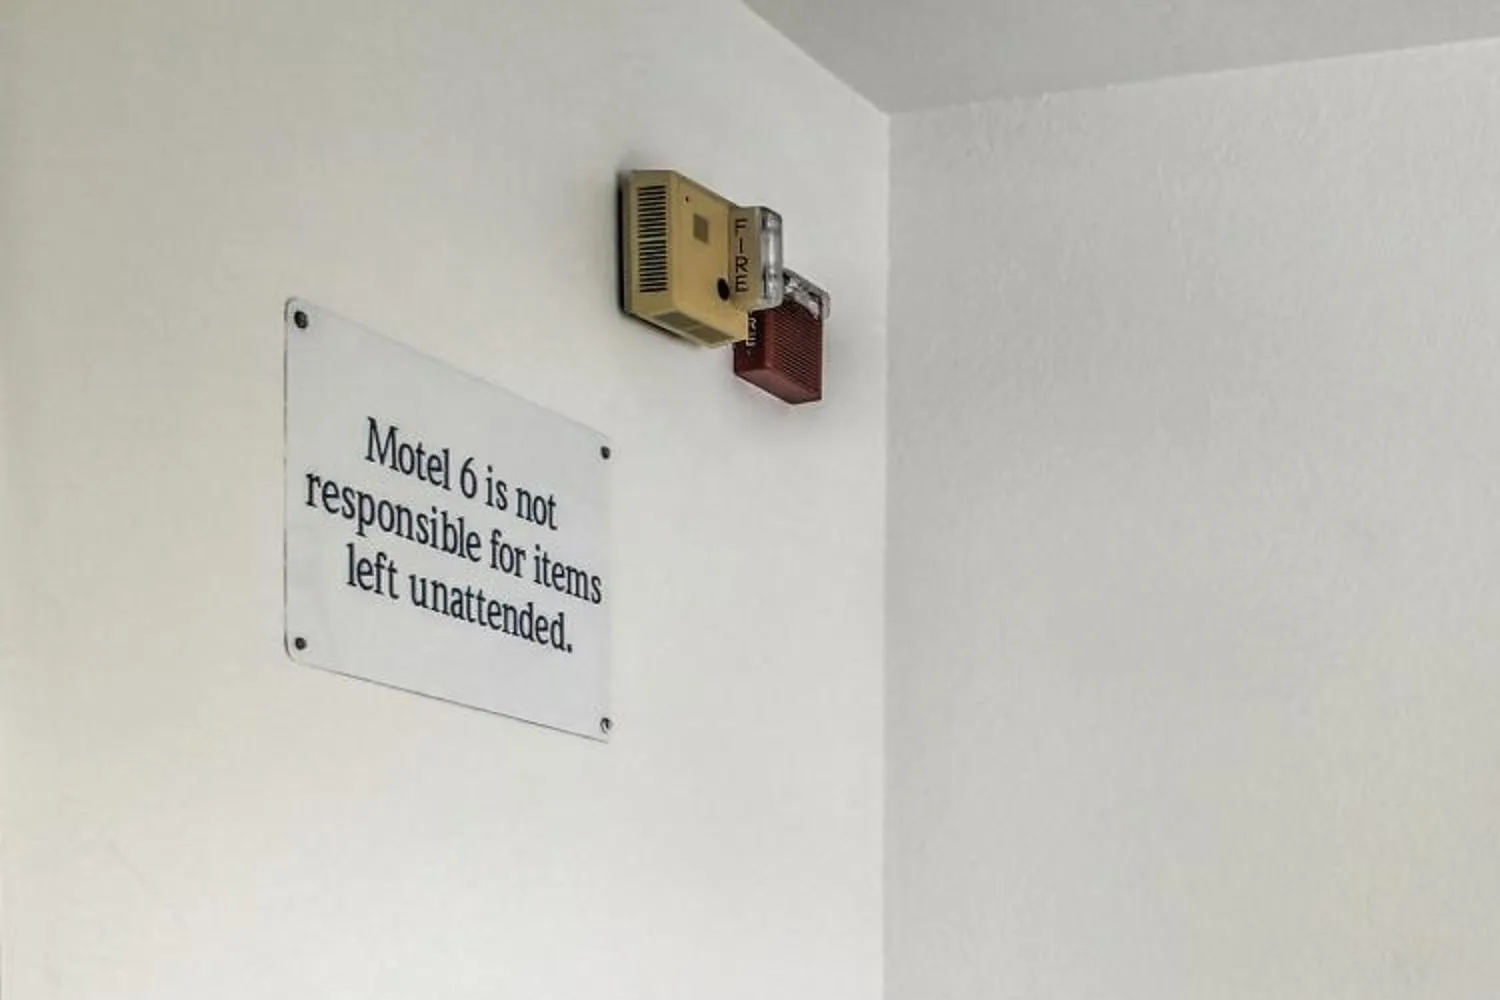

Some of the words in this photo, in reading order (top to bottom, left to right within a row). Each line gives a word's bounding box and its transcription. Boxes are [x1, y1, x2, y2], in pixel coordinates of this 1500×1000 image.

[735, 218, 748, 293] FIRE
[746, 317, 757, 346] RE
[365, 416, 451, 491] Motel
[460, 457, 478, 499] 6
[486, 465, 508, 511] is
[516, 488, 558, 530] not
[305, 473, 482, 562] responsible
[490, 528, 527, 578] for
[533, 544, 602, 604] items
[347, 542, 400, 599] left
[409, 574, 573, 653] unattended.
